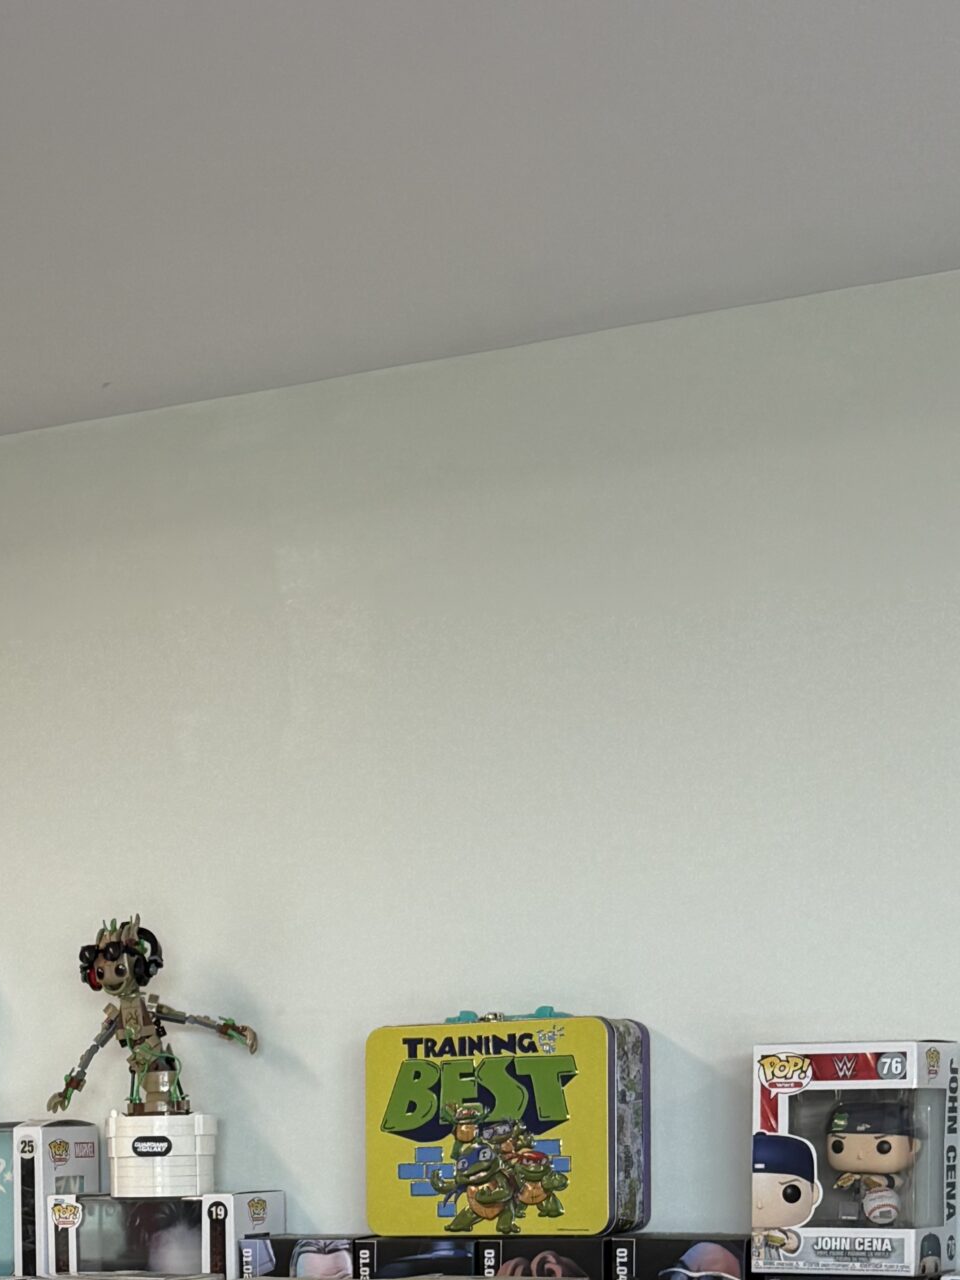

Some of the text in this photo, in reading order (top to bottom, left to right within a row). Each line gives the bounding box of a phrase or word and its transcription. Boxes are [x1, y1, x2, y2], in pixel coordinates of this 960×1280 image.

[402, 1033, 539, 1059] TRAINING
[758, 1054, 902, 1081] POP! 76
[380, 1055, 579, 1142] BEST
[20, 1140, 34, 1154] 25
[48, 1139, 70, 1157] POP!
[946, 1058, 959, 1221] JOHN CENA
[52, 1204, 79, 1220] POP!
[210, 1206, 225, 1219] 19
[813, 1237, 892, 1251] JOHN CENA
